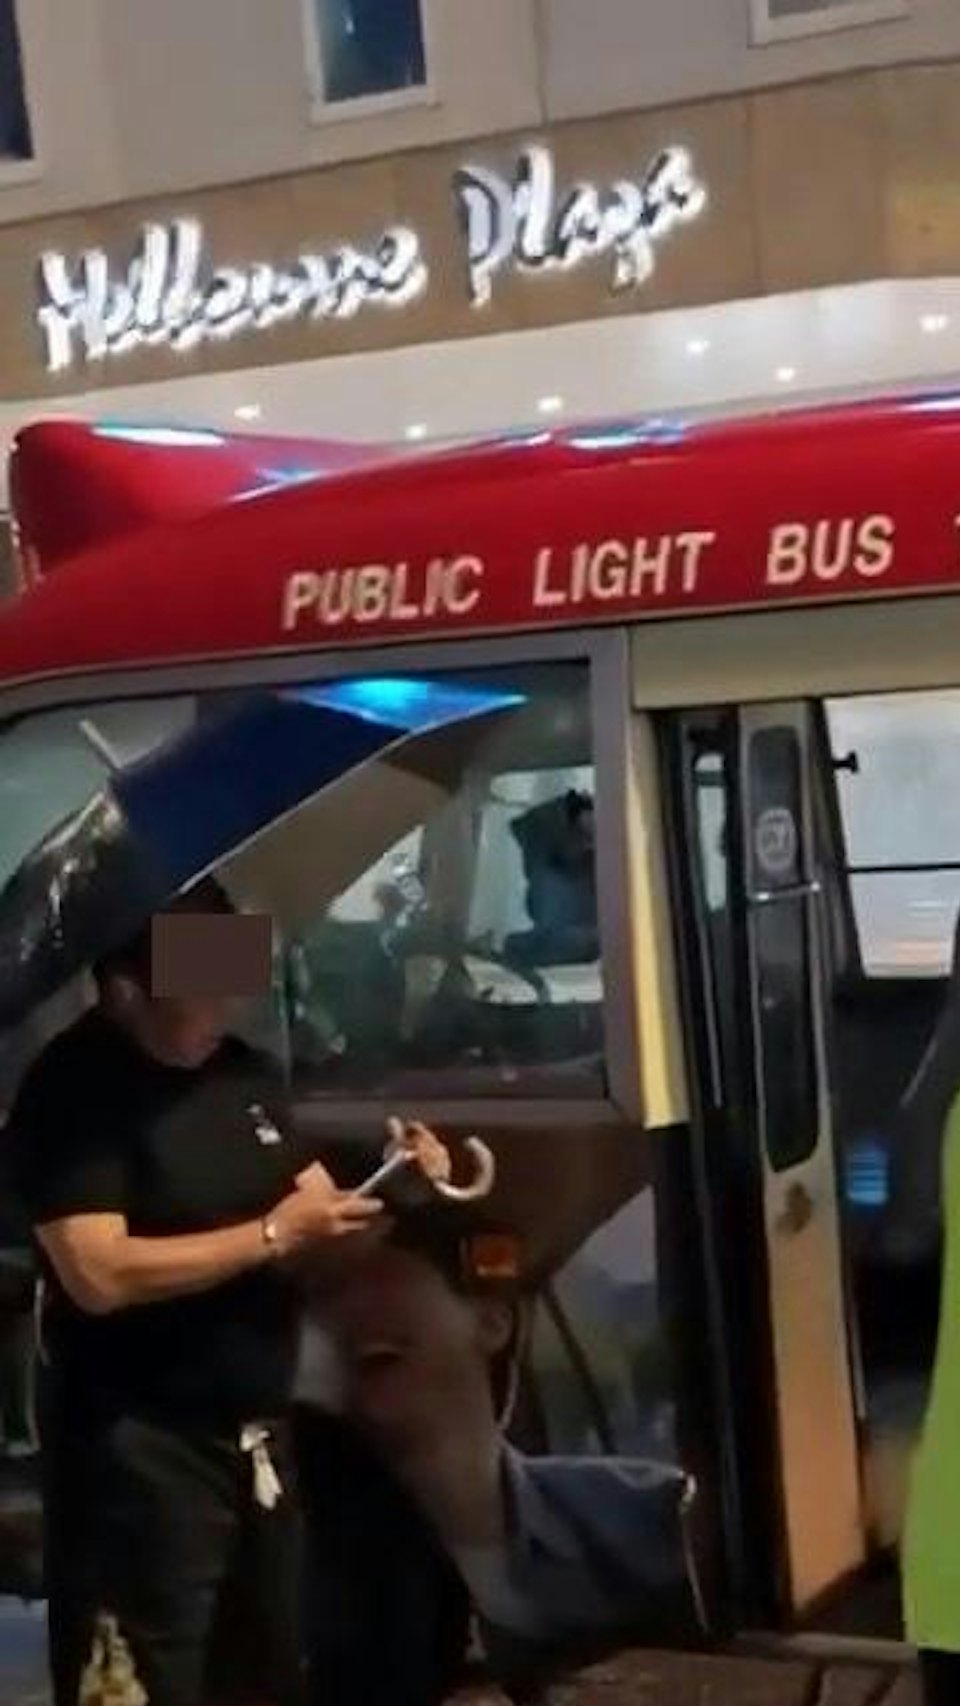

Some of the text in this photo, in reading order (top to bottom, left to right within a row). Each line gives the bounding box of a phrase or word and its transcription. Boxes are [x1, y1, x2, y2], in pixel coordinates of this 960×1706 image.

[452, 144, 706, 308] Plaza
[282, 554, 484, 630] PUBLIC
[532, 530, 715, 608] LIGHT
[766, 513, 895, 586] BUS
